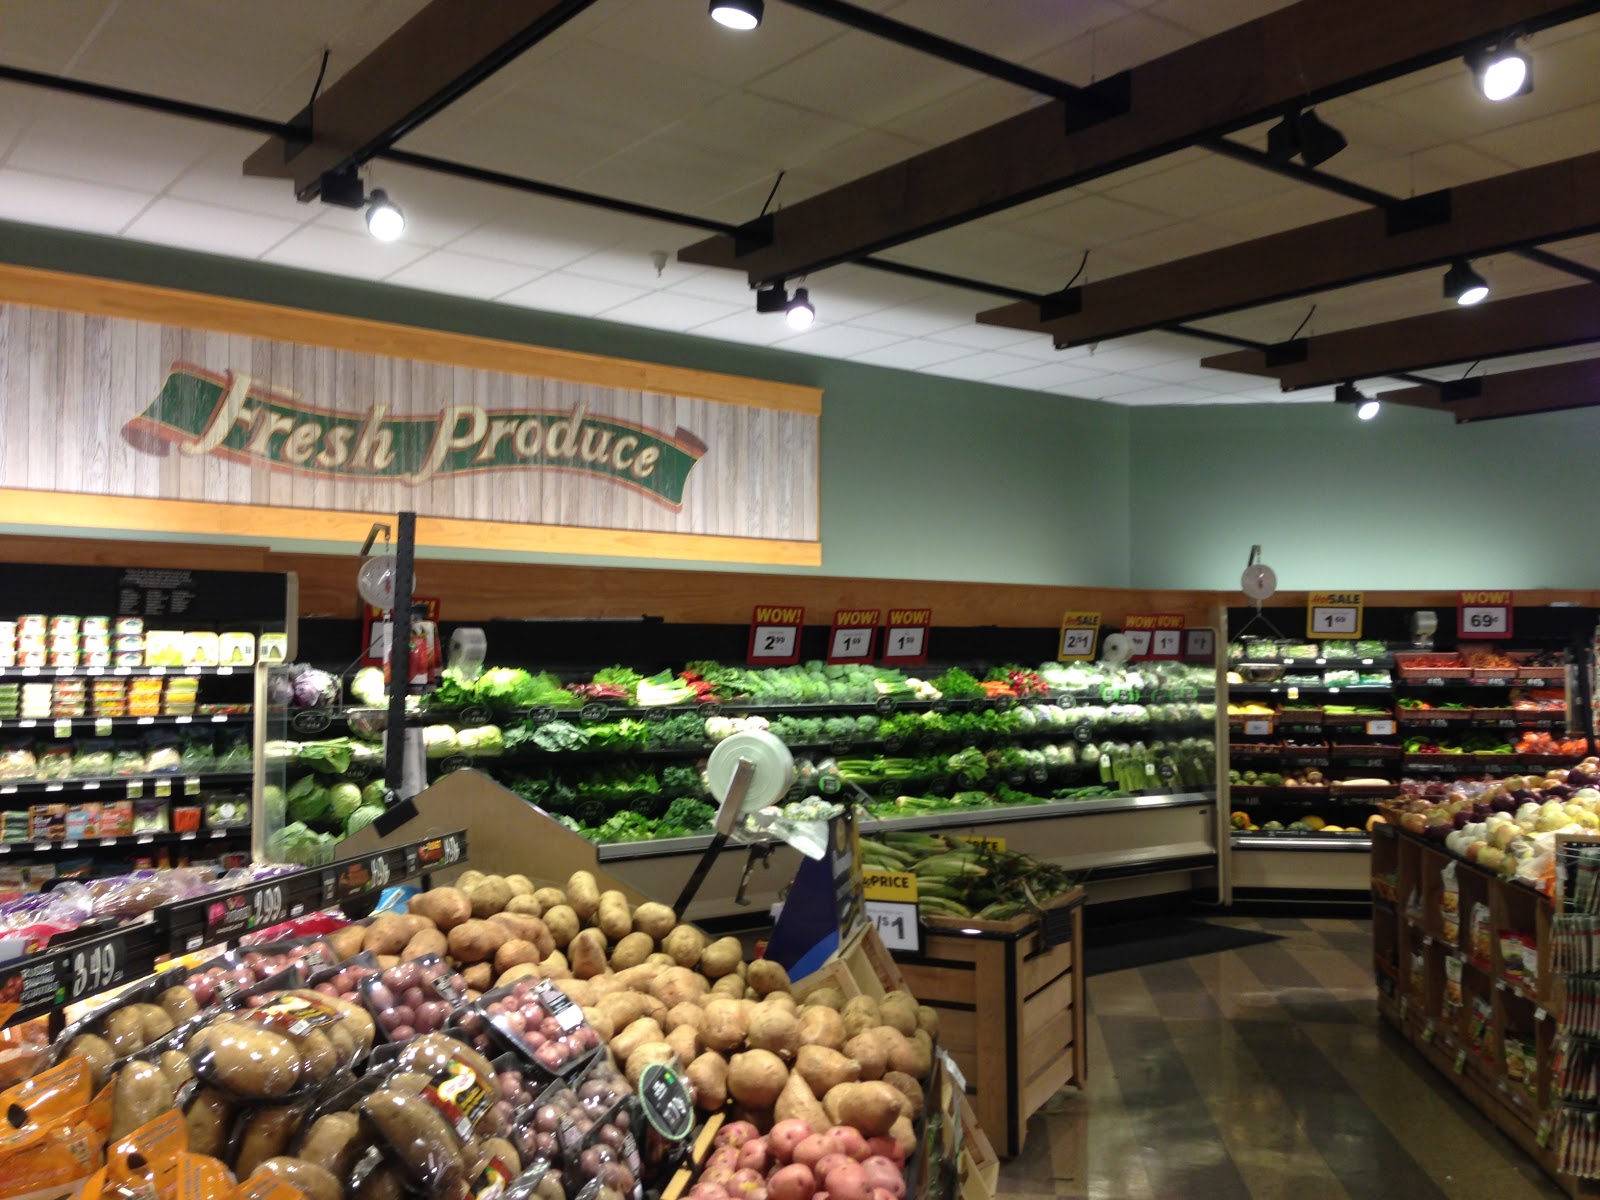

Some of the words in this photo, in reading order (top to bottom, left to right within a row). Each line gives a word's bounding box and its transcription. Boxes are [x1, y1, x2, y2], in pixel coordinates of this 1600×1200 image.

[180, 370, 394, 470] Fresh
[402, 402, 660, 485] Produce
[1329, 594, 1360, 604] SALE
[1462, 591, 1510, 604] WOW!
[757, 607, 801, 623] WOW!
[837, 610, 879, 625] WOW!
[891, 610, 929, 625] WOW!
[871, 875, 910, 889] PRICE
